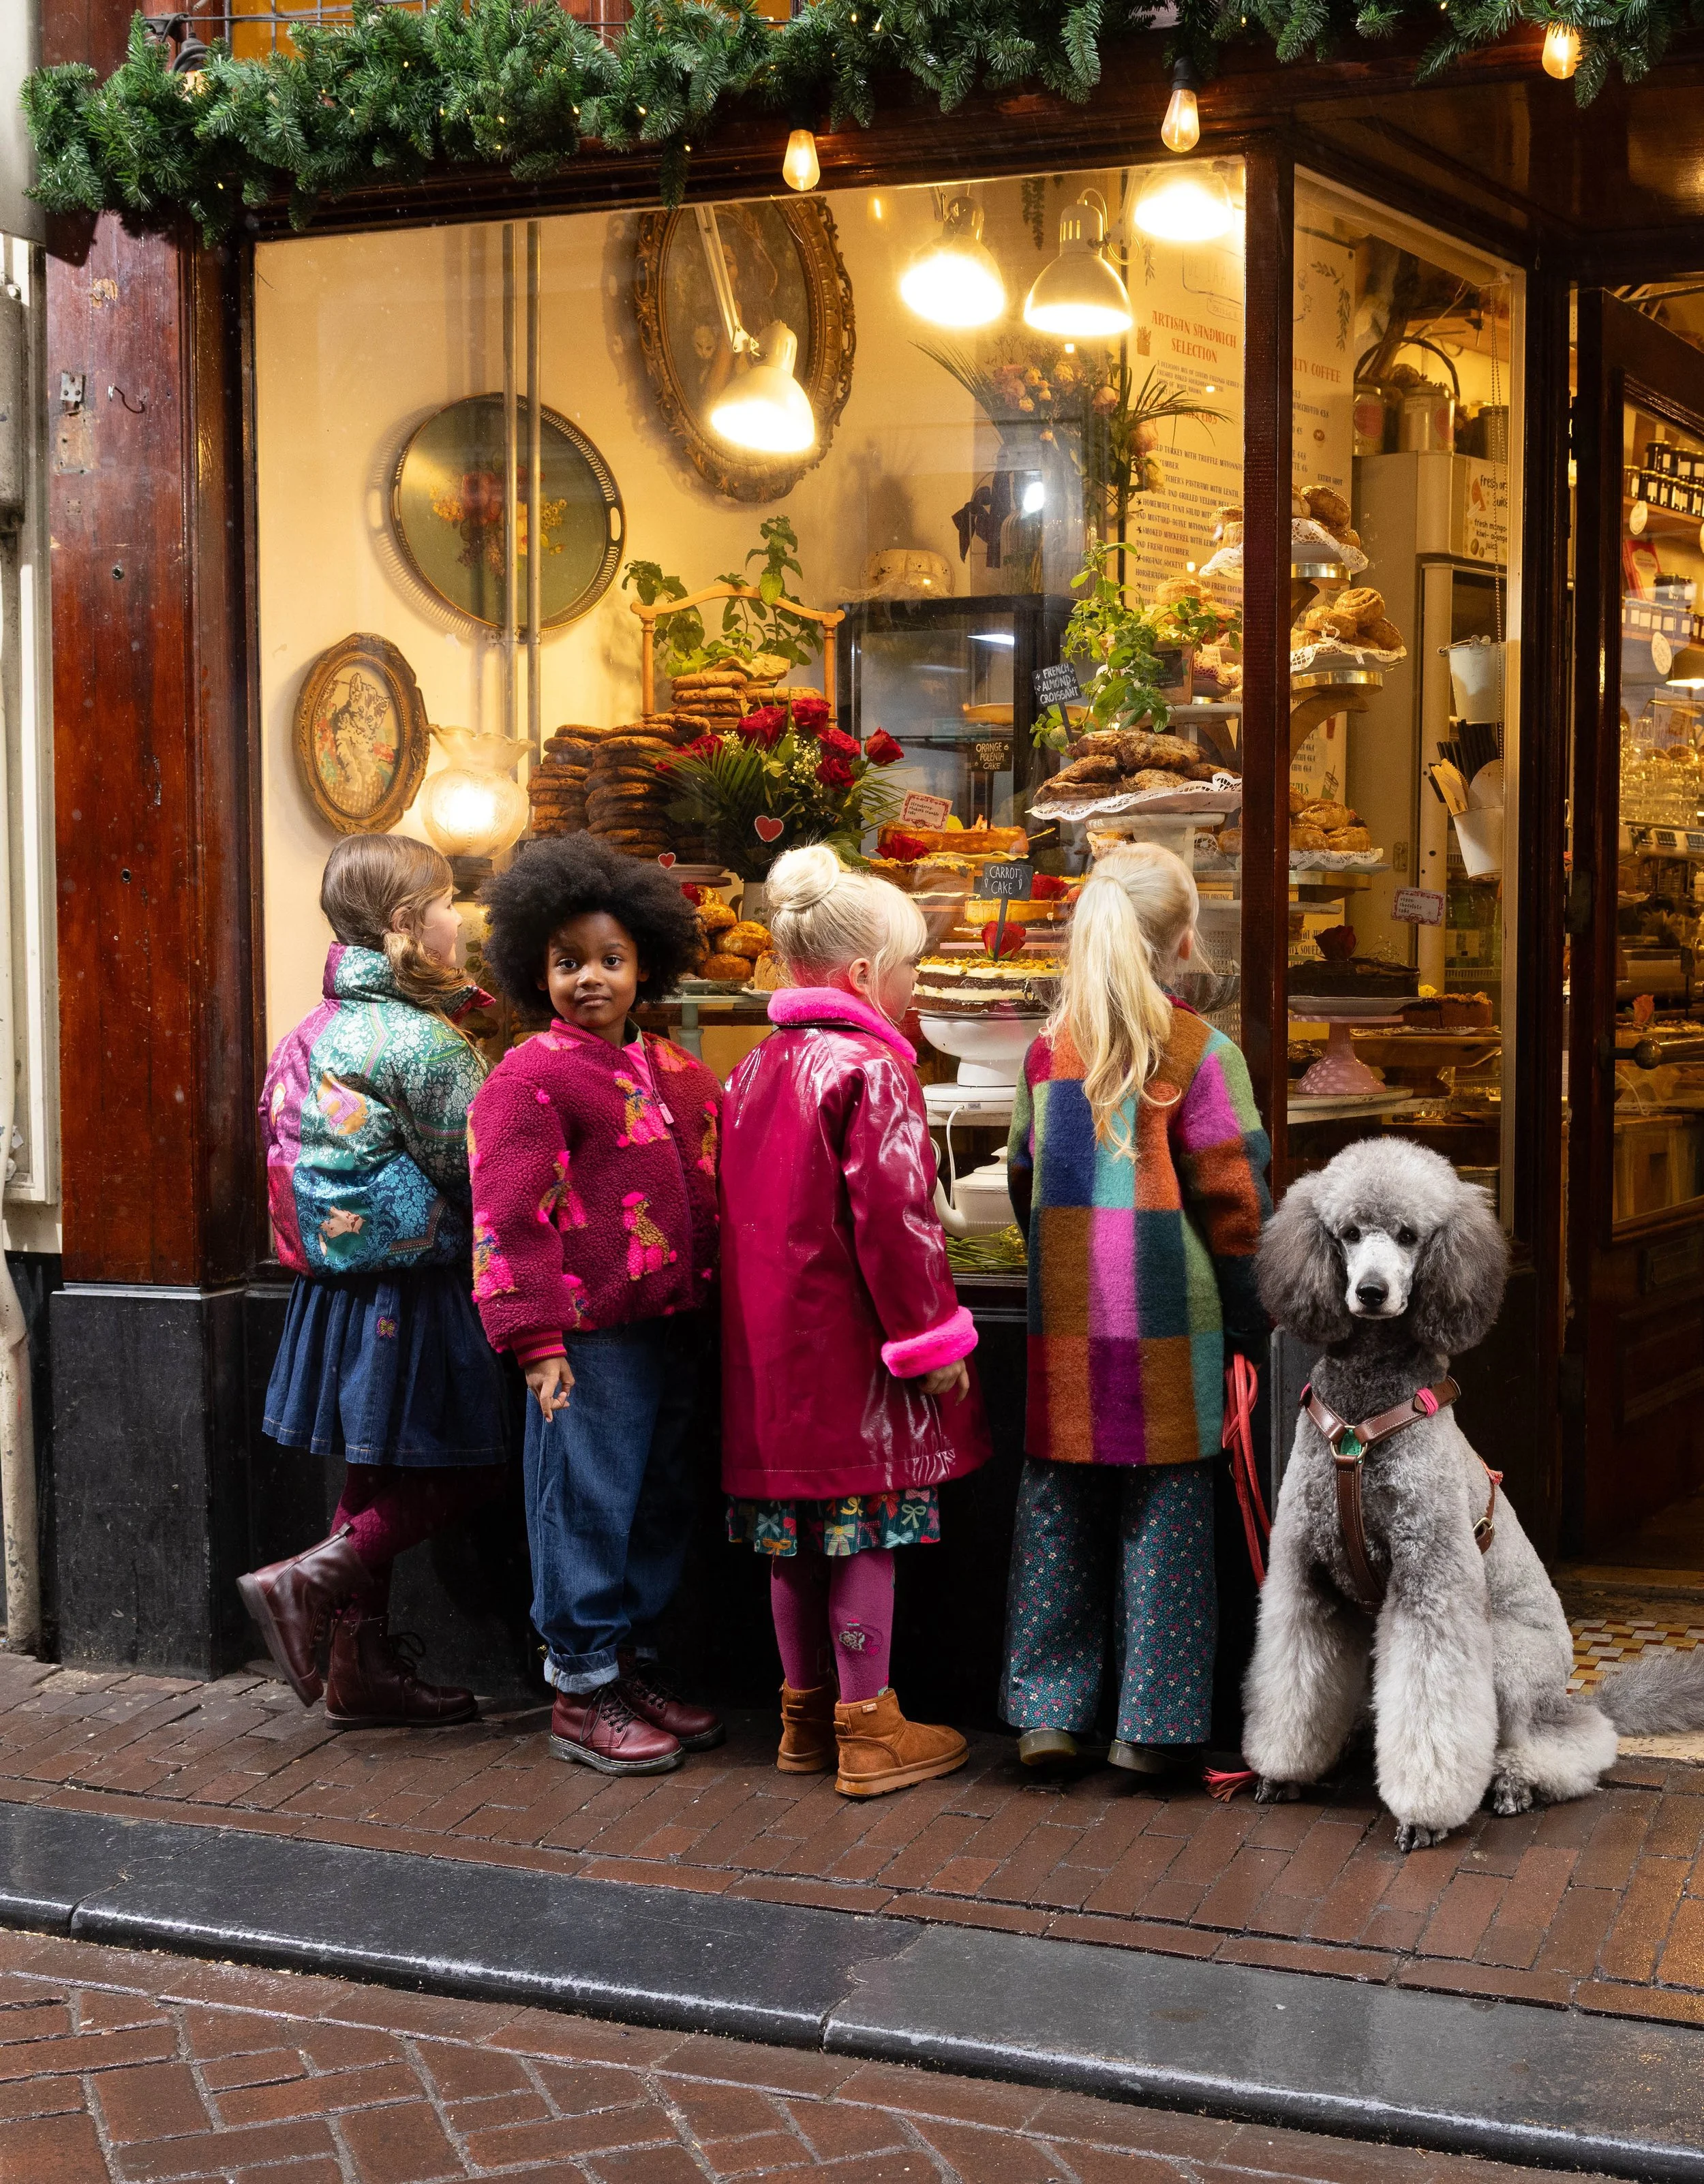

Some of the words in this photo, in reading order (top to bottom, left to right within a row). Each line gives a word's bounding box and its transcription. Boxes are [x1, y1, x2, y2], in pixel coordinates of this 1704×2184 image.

[1152, 311, 1190, 335] ARTISAN
[1193, 324, 1237, 348] SANDWICH
[1172, 338, 1217, 363] SELECTION
[1311, 363, 1341, 383] COFFEE
[1164, 446, 1183, 457] TURKEY
[1184, 450, 1197, 460] WITH
[1198, 454, 1218, 465] TRUFFLE
[1185, 479, 1209, 491] PASTRAMI
[1211, 485, 1222, 494] WITH
[1168, 489, 1178, 497] AND
[1178, 491, 1198, 502] GRILLED
[1200, 496, 1217, 506] YELLOW
[1142, 498, 1170, 510] HOMEMADE
[1172, 504, 1185, 513] TUNA
[1186, 506, 1200, 517] SALAD
[1474, 518, 1488, 527] fresh
[1142, 527, 1163, 537] SMOKED
[1164, 532, 1189, 542] MACKEREL
[1190, 536, 1202, 544] WITH
[1136, 540, 1146, 548] AND
[1147, 542, 1163, 552] FRESH
[1164, 545, 1189, 556] CUCUMBER
[1142, 556, 1162, 566] ORGANIC
[1163, 559, 1184, 570] SOCKEYE
[1211, 582, 1226, 591] FRESH
[1043, 663, 1069, 679] FRENCH
[1042, 675, 1071, 692] ALMOND
[1040, 686, 1078, 704] CROISSANT
[975, 742, 1002, 752] ORANGE
[979, 752, 1005, 762] POLENTA
[983, 762, 1001, 770] CAKE
[989, 865, 1020, 879] CARROT
[991, 880, 1013, 895] CAKE
